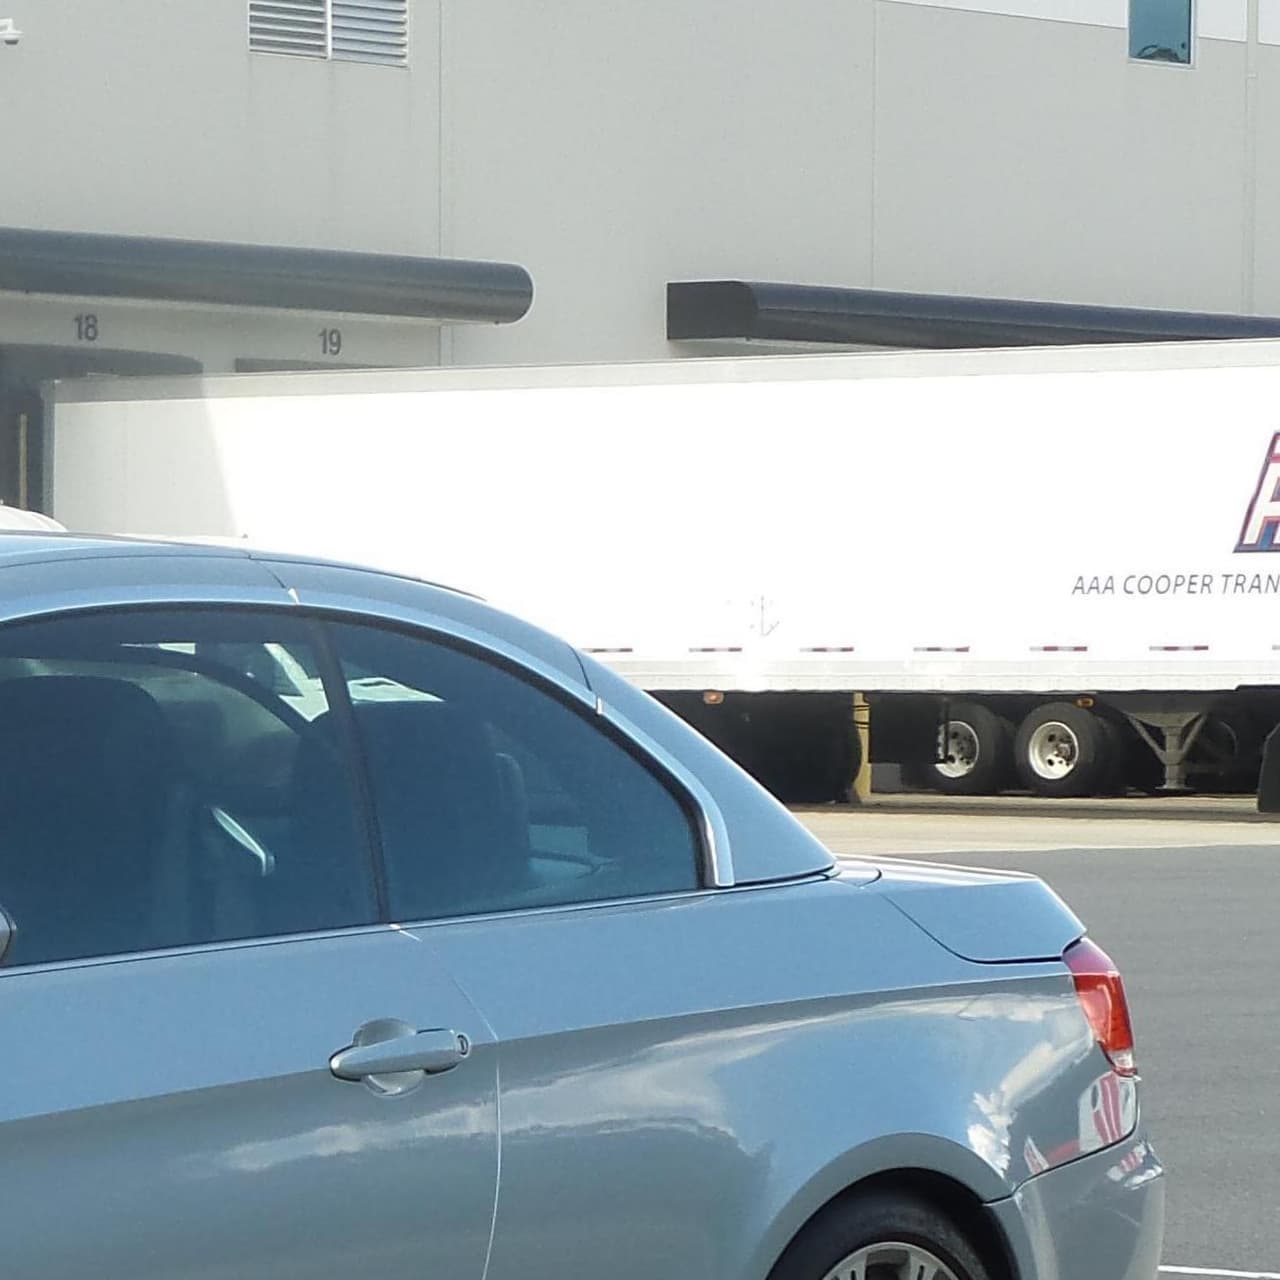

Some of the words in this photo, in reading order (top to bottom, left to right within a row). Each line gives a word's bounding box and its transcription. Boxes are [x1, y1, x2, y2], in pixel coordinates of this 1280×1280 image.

[73, 313, 99, 341] 18
[319, 328, 341, 355] 19
[1072, 575, 1115, 594] AAA
[1123, 574, 1214, 595] COOPER
